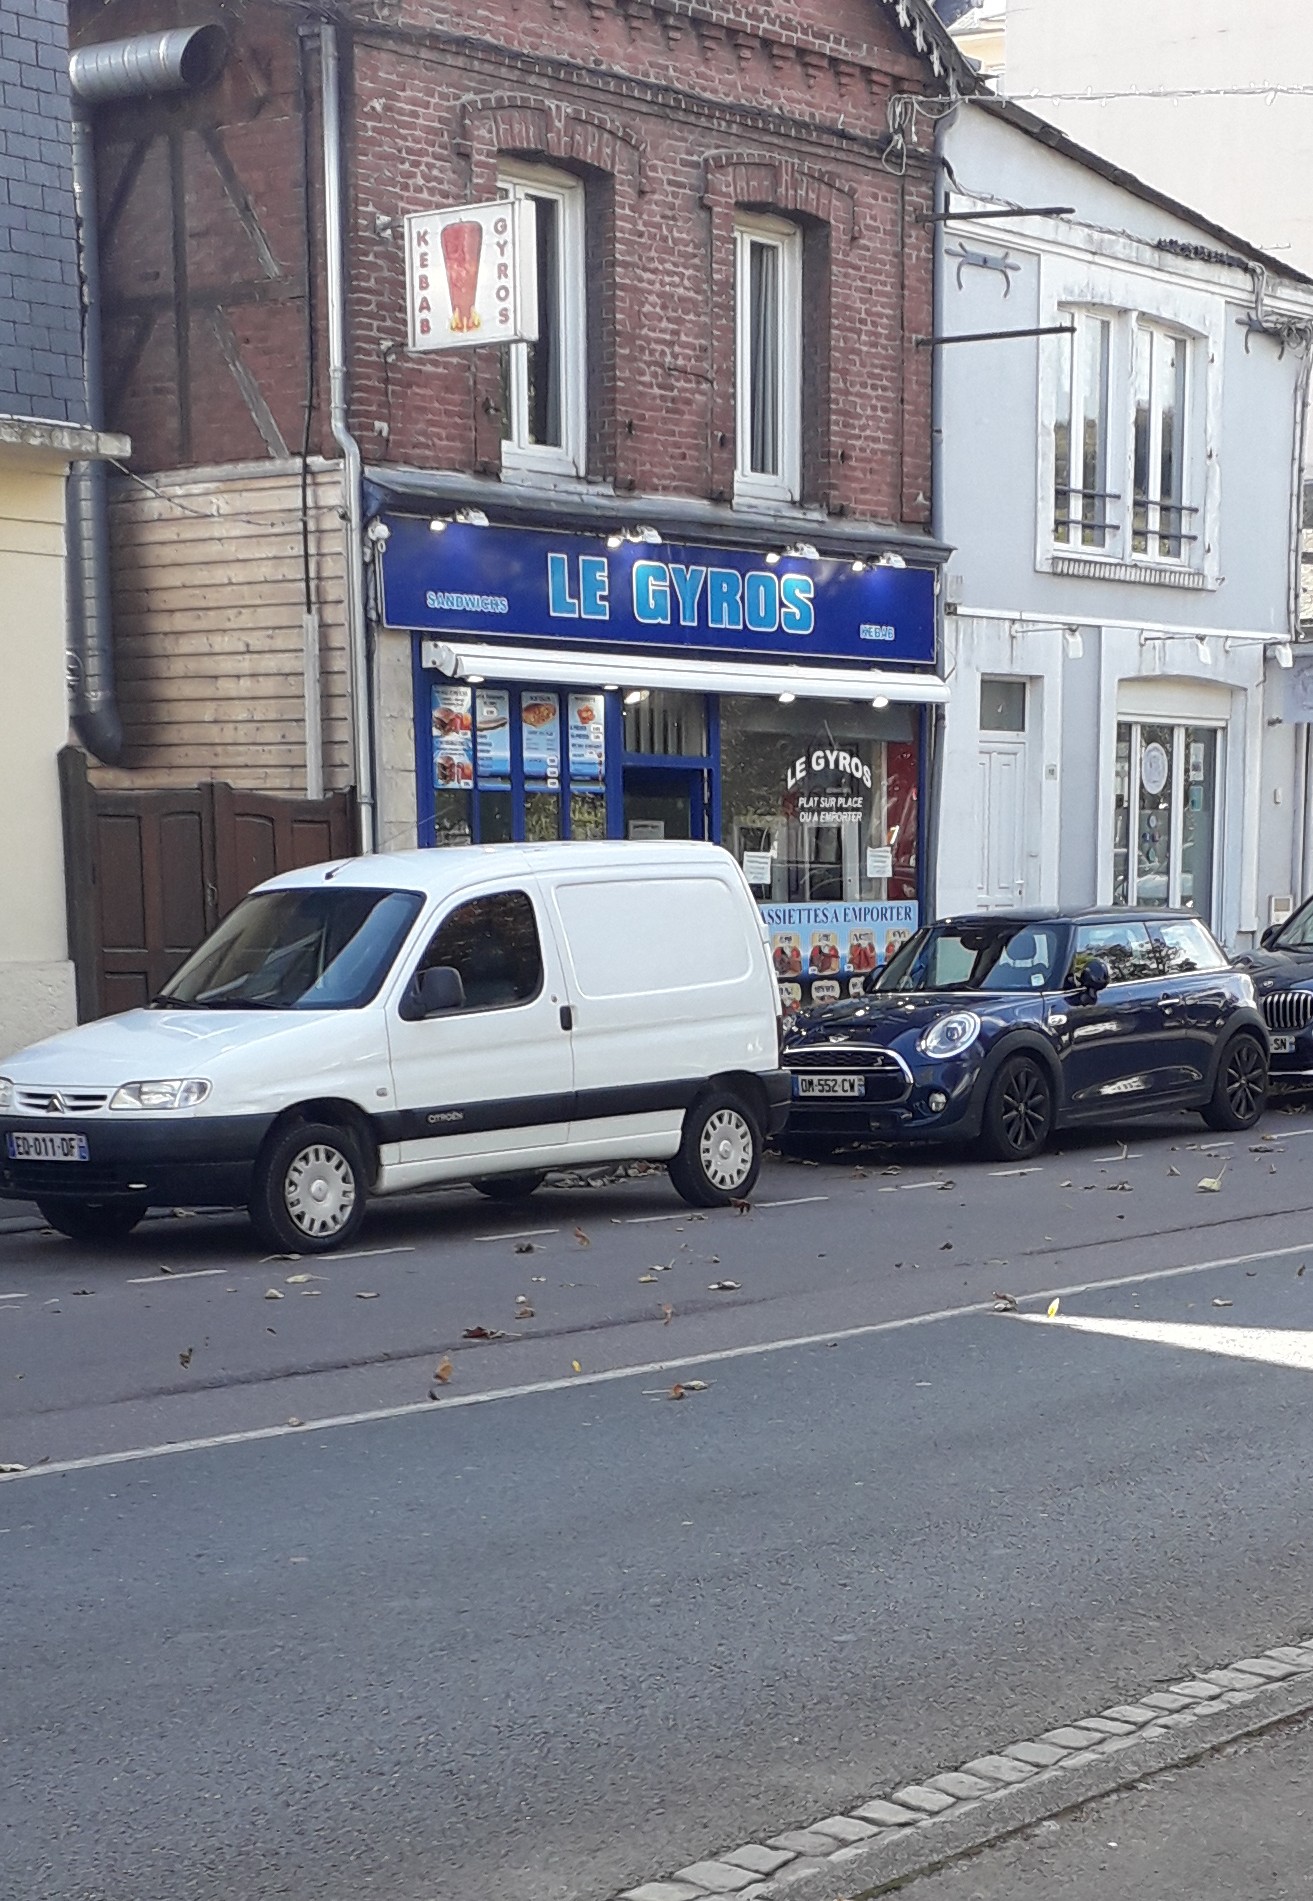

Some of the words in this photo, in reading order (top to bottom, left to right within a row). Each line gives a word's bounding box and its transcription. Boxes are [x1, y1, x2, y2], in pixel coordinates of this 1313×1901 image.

[416, 229, 432, 335] KEBAB
[493, 217, 511, 325] GYROS
[547, 552, 610, 620] LE
[632, 559, 815, 635] GYROS
[787, 755, 807, 790] LE
[811, 749, 872, 789] GYROS
[798, 797, 819, 808] PLAT
[820, 797, 837, 808] SUR
[837, 797, 863, 808] PLACE
[799, 811, 812, 822] OU
[820, 811, 862, 822] EMPORTER
[830, 908, 839, 923] A
[843, 905, 912, 923] EMPORTER
